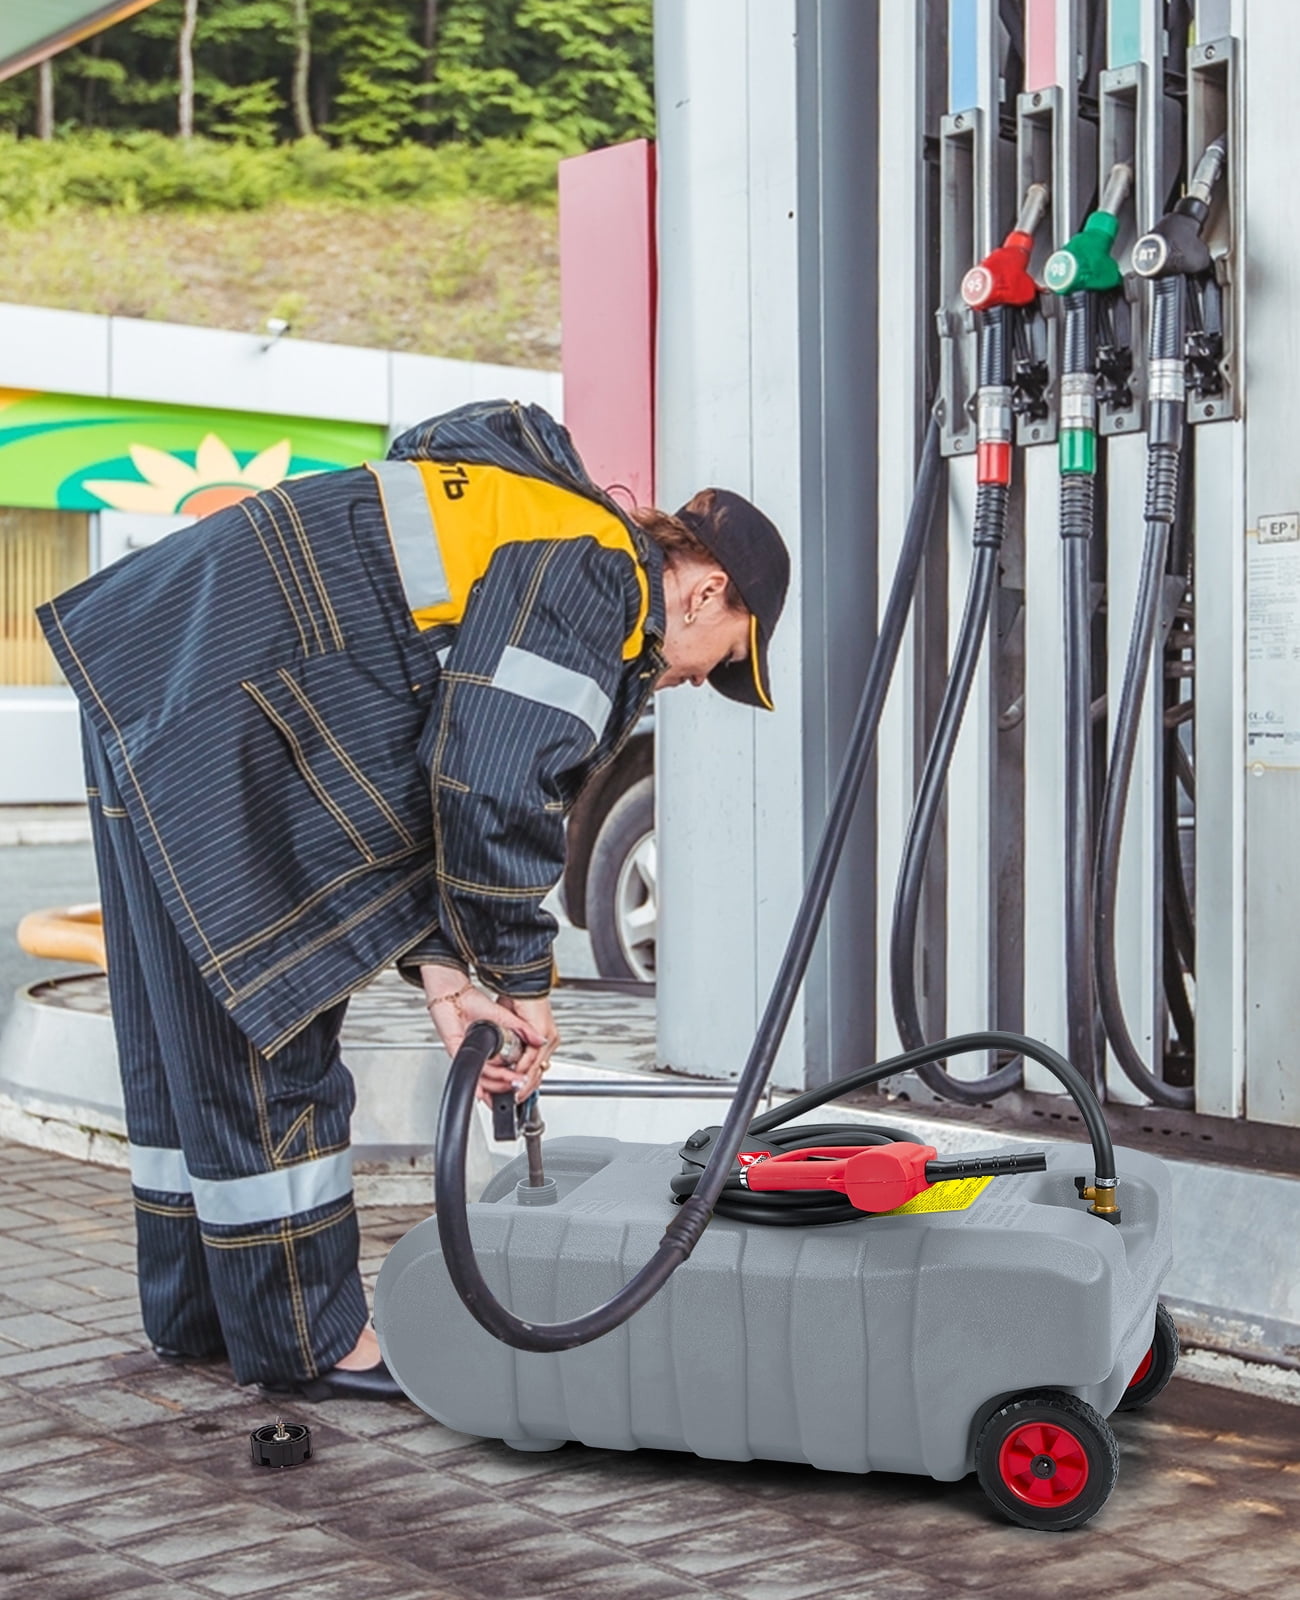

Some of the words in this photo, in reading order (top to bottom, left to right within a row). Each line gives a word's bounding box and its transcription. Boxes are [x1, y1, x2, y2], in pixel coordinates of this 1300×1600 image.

[1051, 263, 1066, 276] 98
[967, 279, 982, 293] 95
[439, 464, 469, 500] ТЬ
[1270, 521, 1288, 535] EP
